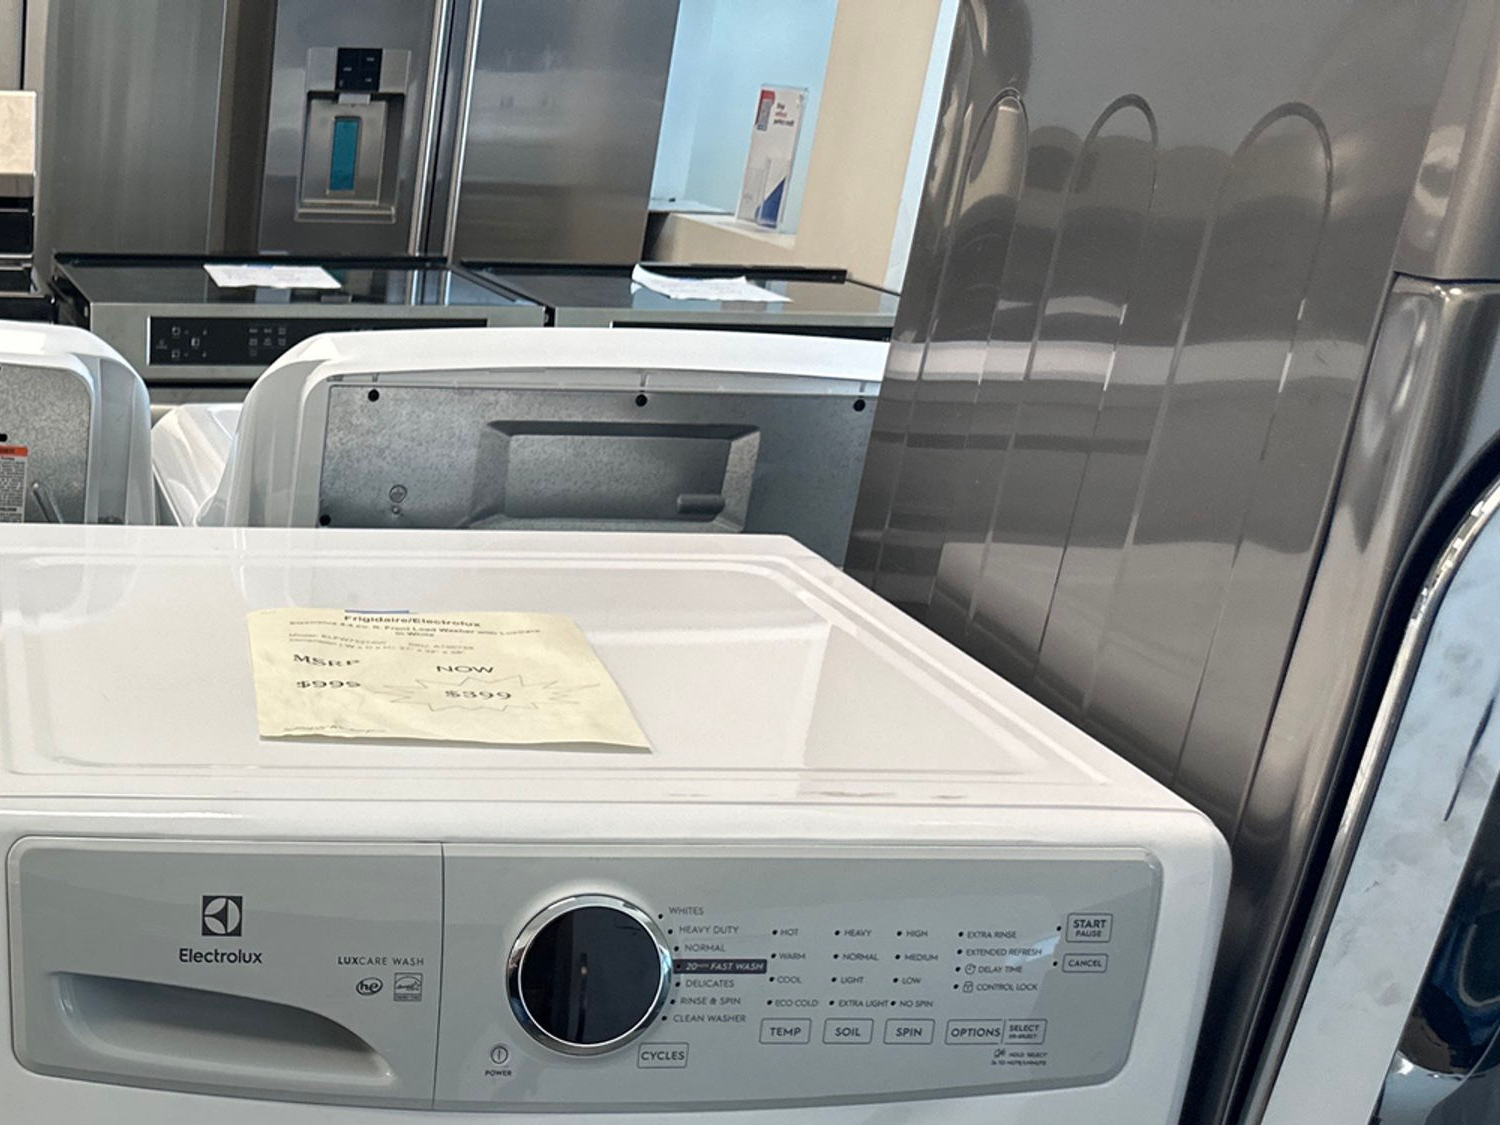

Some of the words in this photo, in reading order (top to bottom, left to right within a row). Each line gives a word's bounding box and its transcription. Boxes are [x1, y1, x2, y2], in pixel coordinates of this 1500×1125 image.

[293, 654, 361, 667] MSRP
[436, 665, 494, 673] NOW
[296, 680, 361, 689] $999
[444, 690, 512, 700] $399
[669, 907, 704, 915] WHITES
[1073, 919, 1107, 929] START
[679, 926, 710, 934] HEAVY
[713, 926, 739, 934] DUTY
[684, 944, 725, 952] NORMAL
[966, 948, 1007, 956] EXTENDED
[1008, 948, 1042, 956] REFRESH
[179, 948, 262, 964] Electrolux
[338, 957, 387, 965] LUXCARE
[393, 957, 424, 966] WASH
[1068, 960, 1102, 968] CANCEL
[710, 963, 734, 971] FAST
[735, 963, 764, 971] WASH
[777, 976, 802, 984] COOL
[841, 976, 864, 984] LIGHT
[976, 983, 1014, 991] CONTROL
[1016, 983, 1038, 991] LOCK
[680, 997, 708, 1005] RINSE
[720, 997, 741, 1005] SPIN
[673, 1014, 705, 1022] CLEAN
[707, 1014, 747, 1022] WASHER
[770, 1028, 801, 1036] TEMP
[835, 1028, 861, 1036] SOIL
[1009, 1024, 1039, 1032] SELECT
[896, 1028, 923, 1037] SPIN
[951, 1028, 1001, 1037] OPTIONS
[640, 1051, 685, 1061] CYCLES
